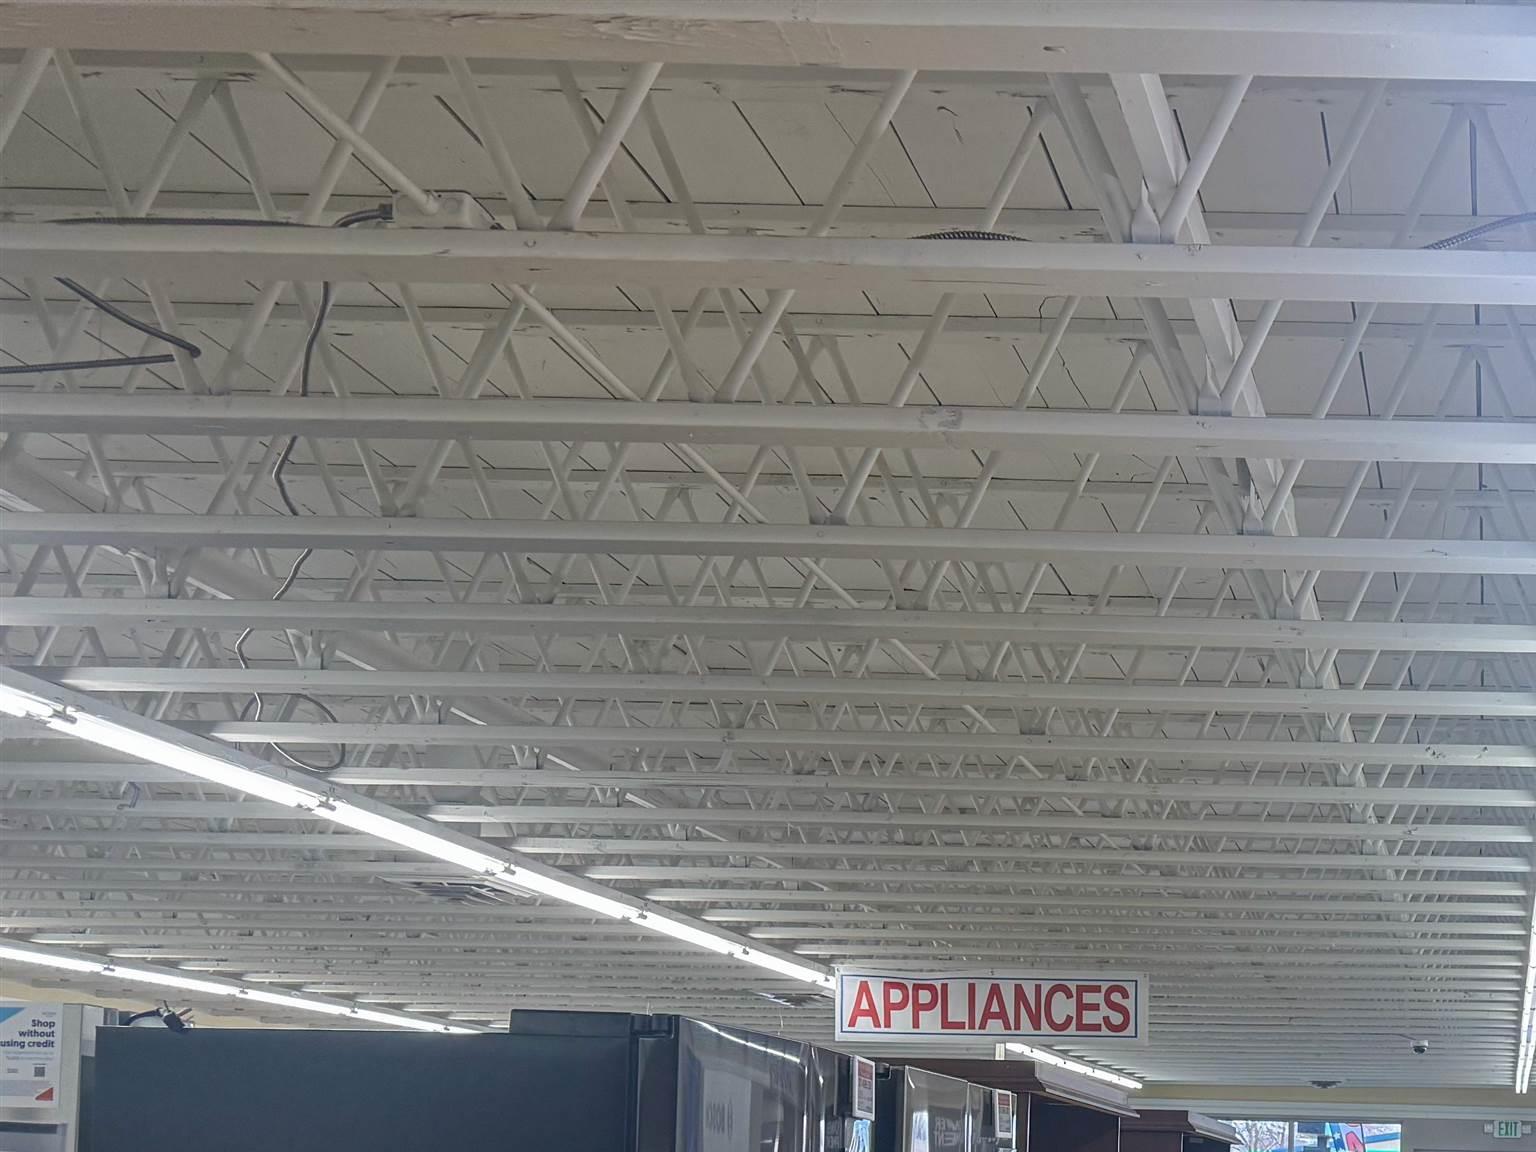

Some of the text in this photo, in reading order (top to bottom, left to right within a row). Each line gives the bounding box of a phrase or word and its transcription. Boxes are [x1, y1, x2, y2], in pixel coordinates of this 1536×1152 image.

[848, 979, 1131, 1032] APPLIANCES
[31, 1019, 56, 1029] Shop
[18, 1029, 55, 1038] without
[0, 1039, 55, 1049] using credit
[1498, 1121, 1519, 1137] EXIT
